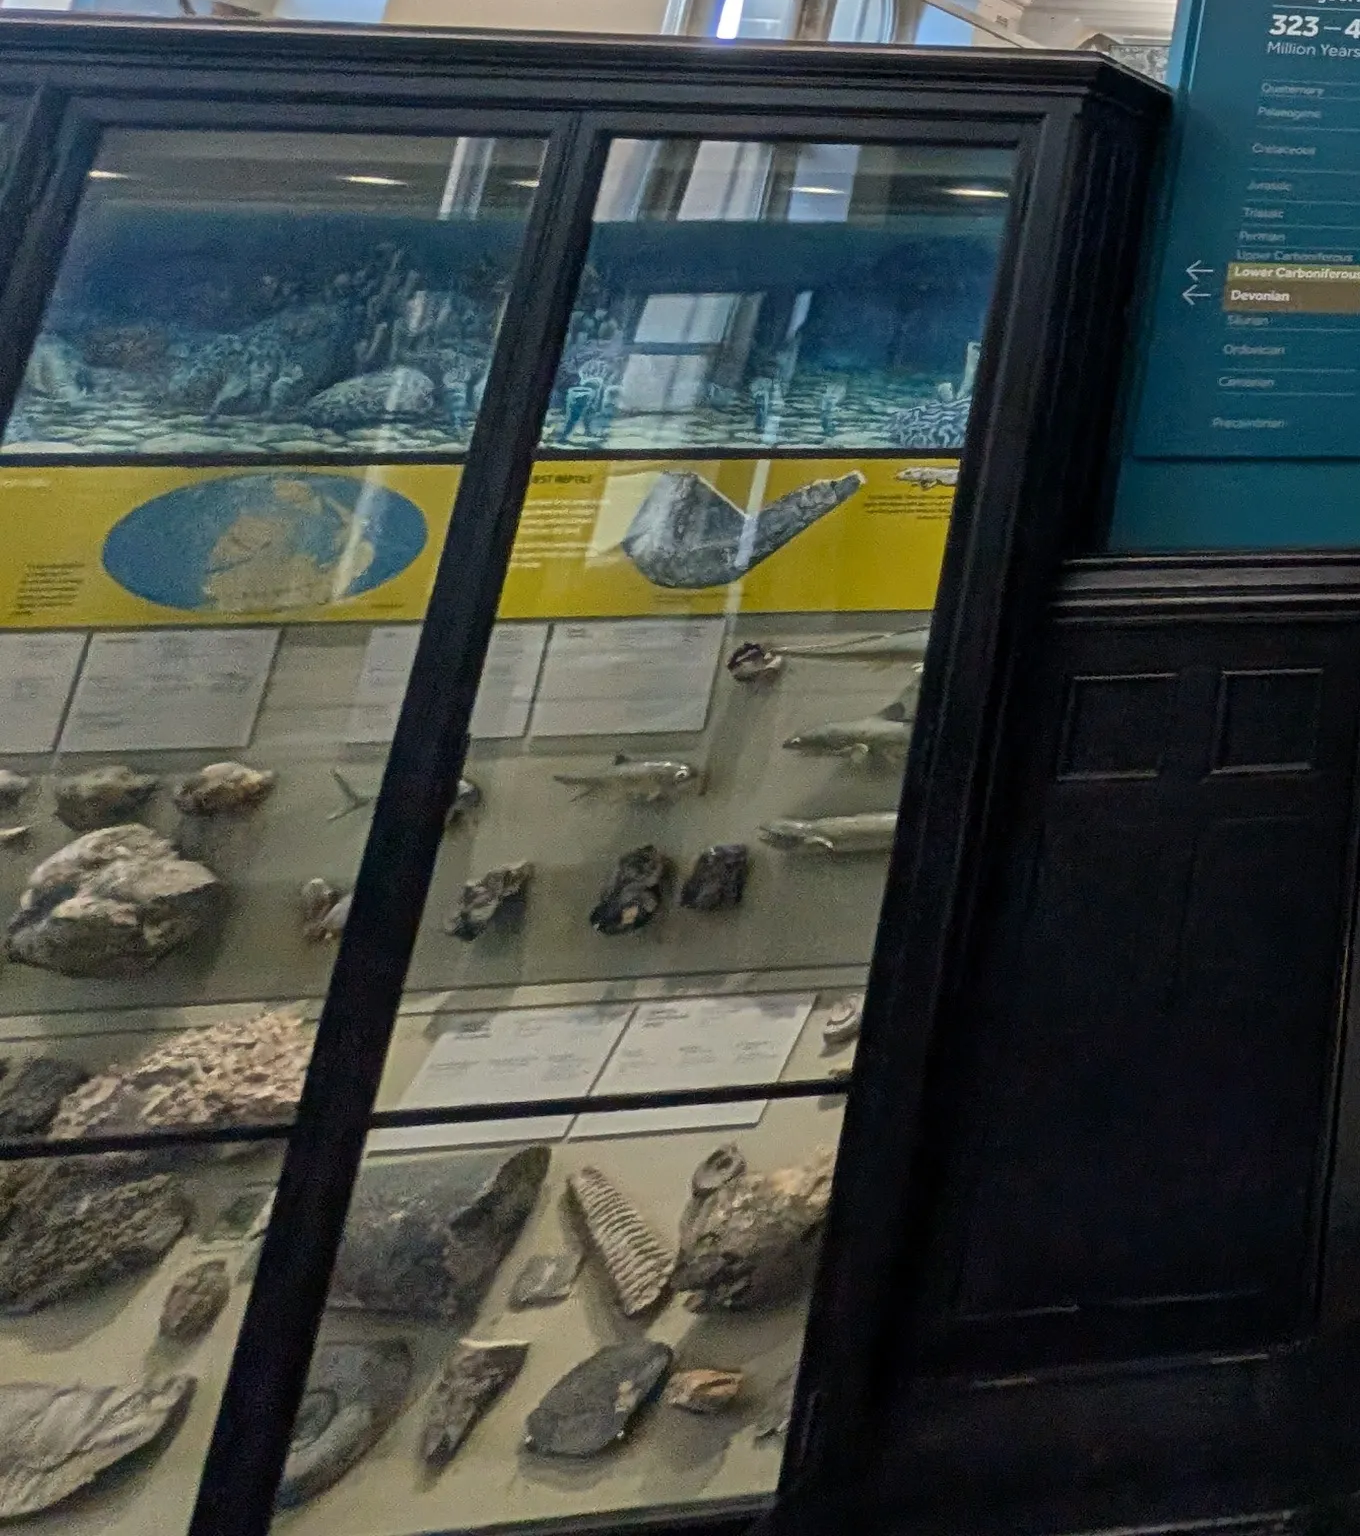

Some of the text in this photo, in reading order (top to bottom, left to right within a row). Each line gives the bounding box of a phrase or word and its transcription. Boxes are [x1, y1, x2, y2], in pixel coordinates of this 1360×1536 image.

[1268, 13, 1320, 37] 323
[1266, 41, 1316, 56] Million
[1320, 44, 1360, 58] Years
[1234, 266, 1273, 278] Lower
[1230, 289, 1290, 302] Devonian
